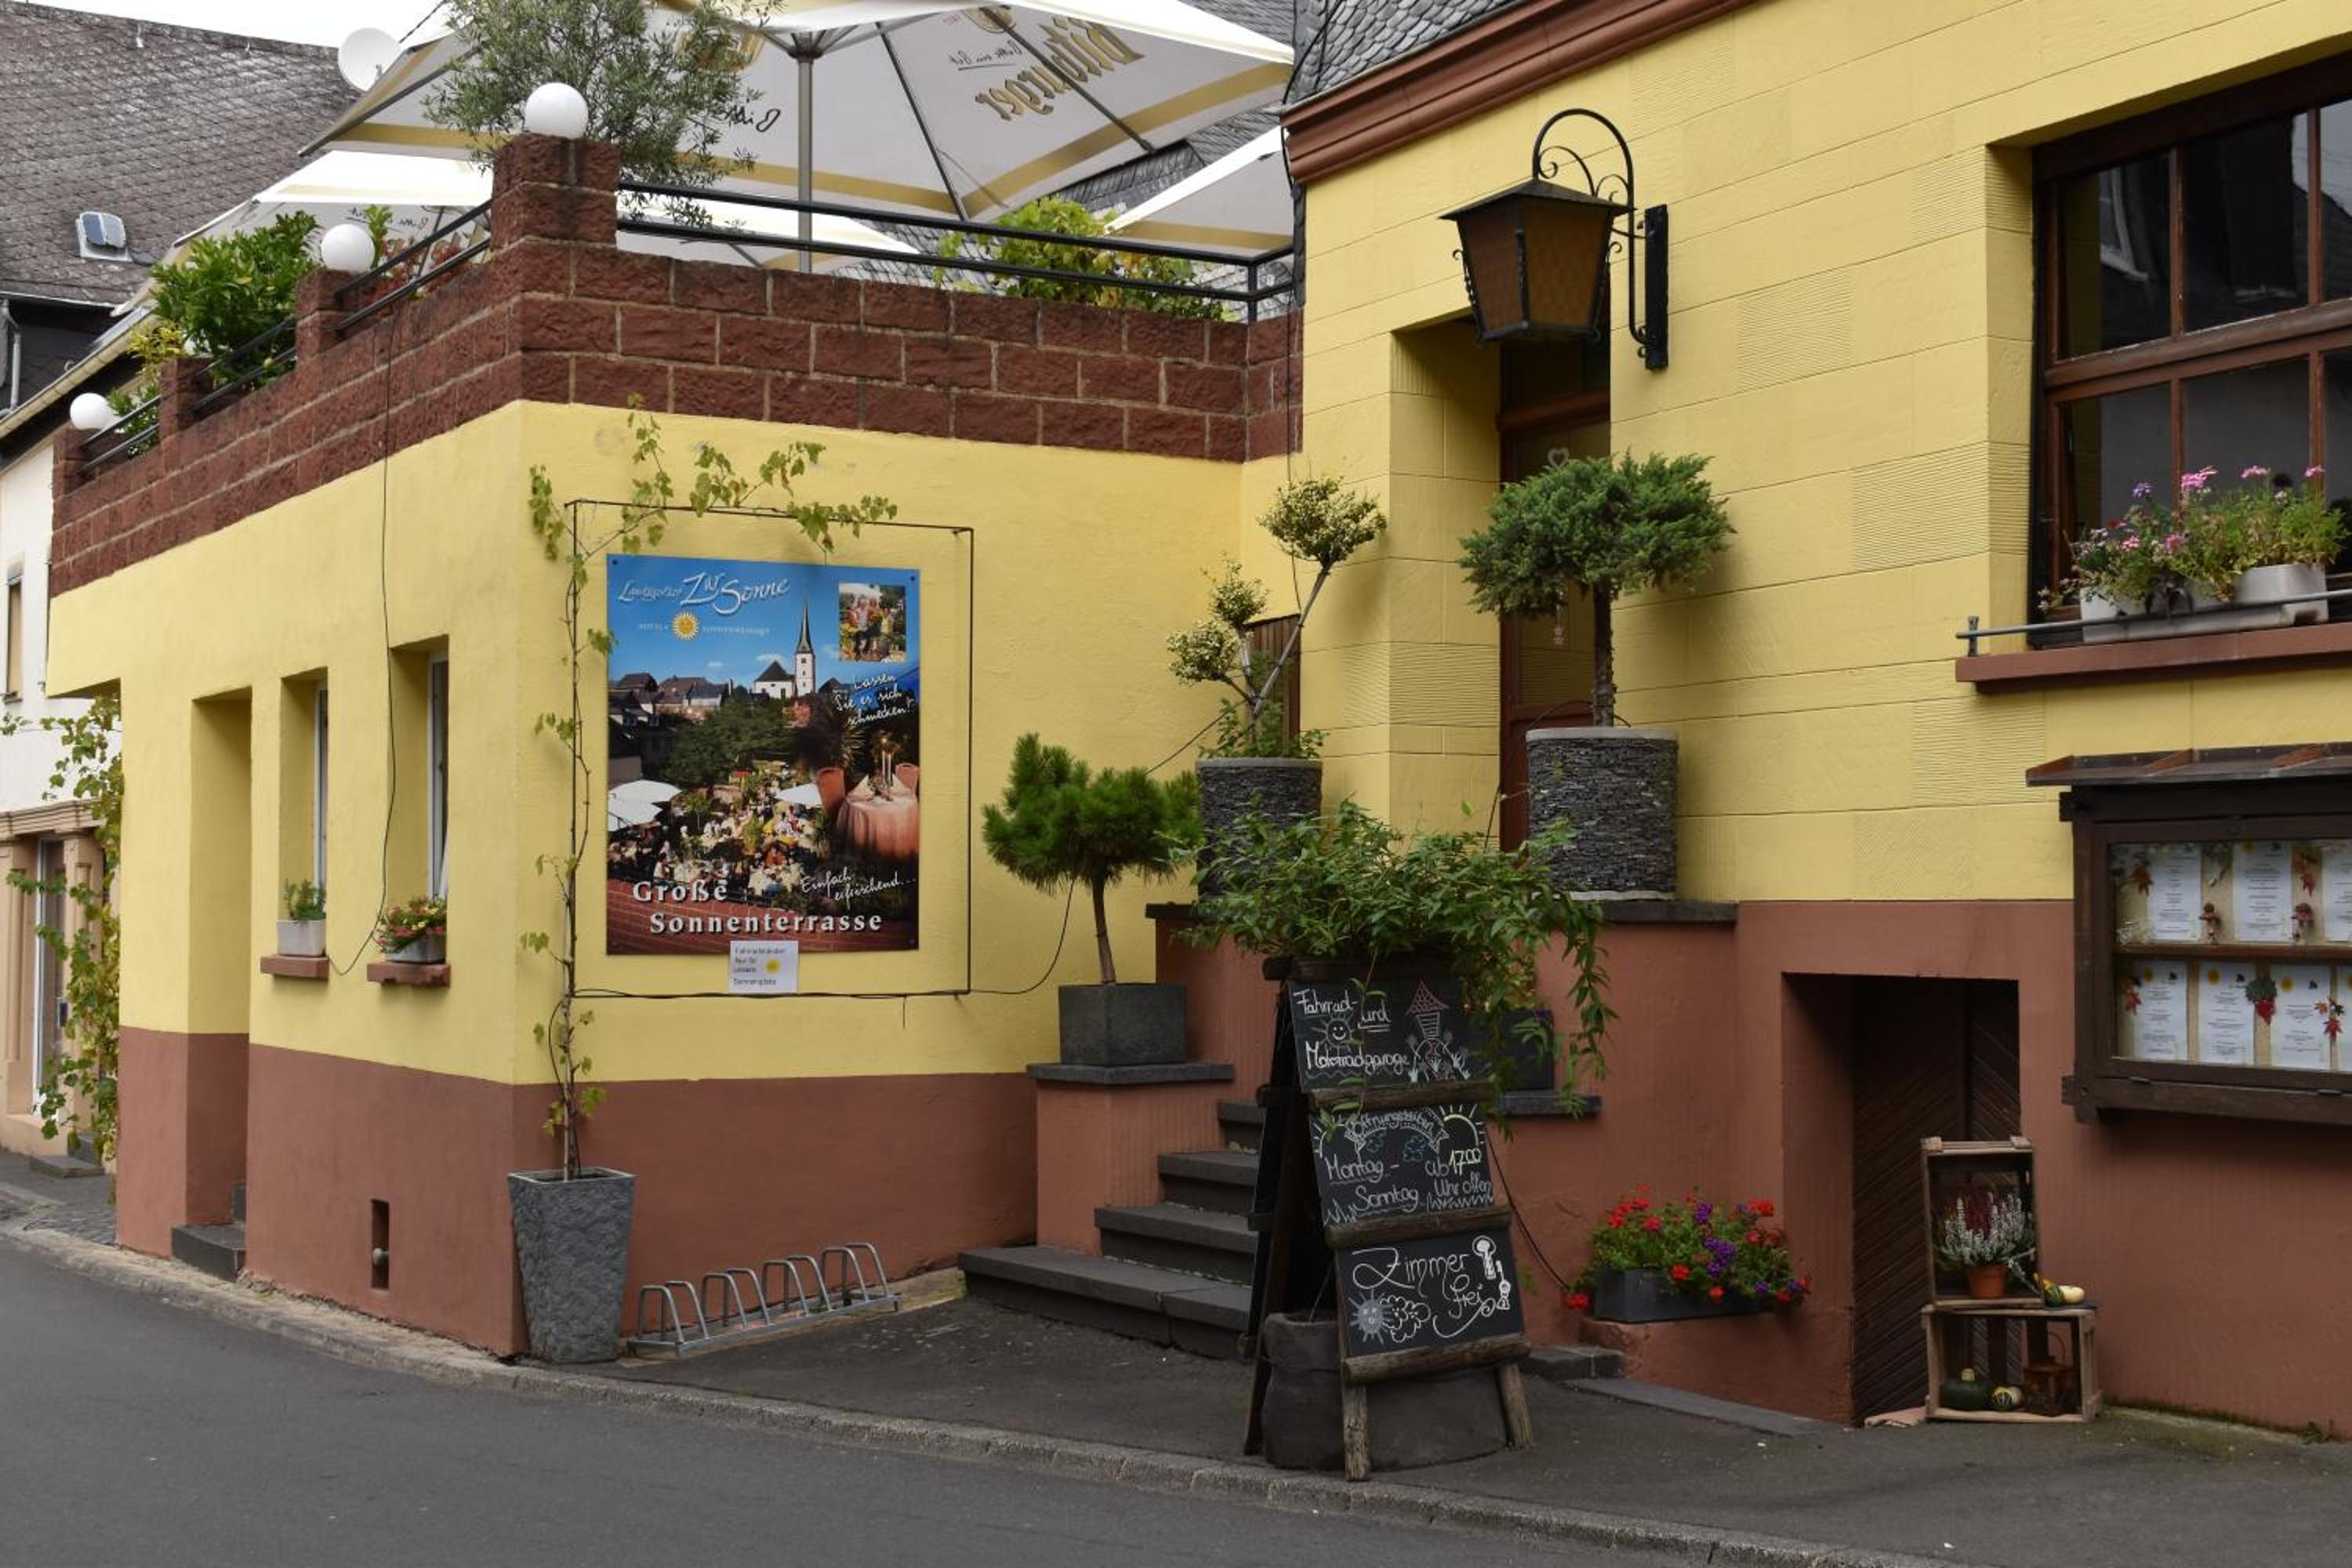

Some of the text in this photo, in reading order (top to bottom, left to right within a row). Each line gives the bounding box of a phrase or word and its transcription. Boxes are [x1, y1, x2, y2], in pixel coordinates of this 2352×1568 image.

[713, 578, 790, 615] Sonne
[878, 683, 902, 701] sich
[632, 879, 728, 903] Große
[801, 866, 853, 898] Einfach
[650, 912, 883, 935] Sonnenterrasse
[1362, 998, 1392, 1023] und
[1324, 1153, 1384, 1184] Montag
[1356, 1185, 1419, 1213] Sonntag
[1434, 1178, 1459, 1197] Uhr
[1352, 1247, 1470, 1300] Zimmer
[1449, 1274, 1483, 1319] frei
